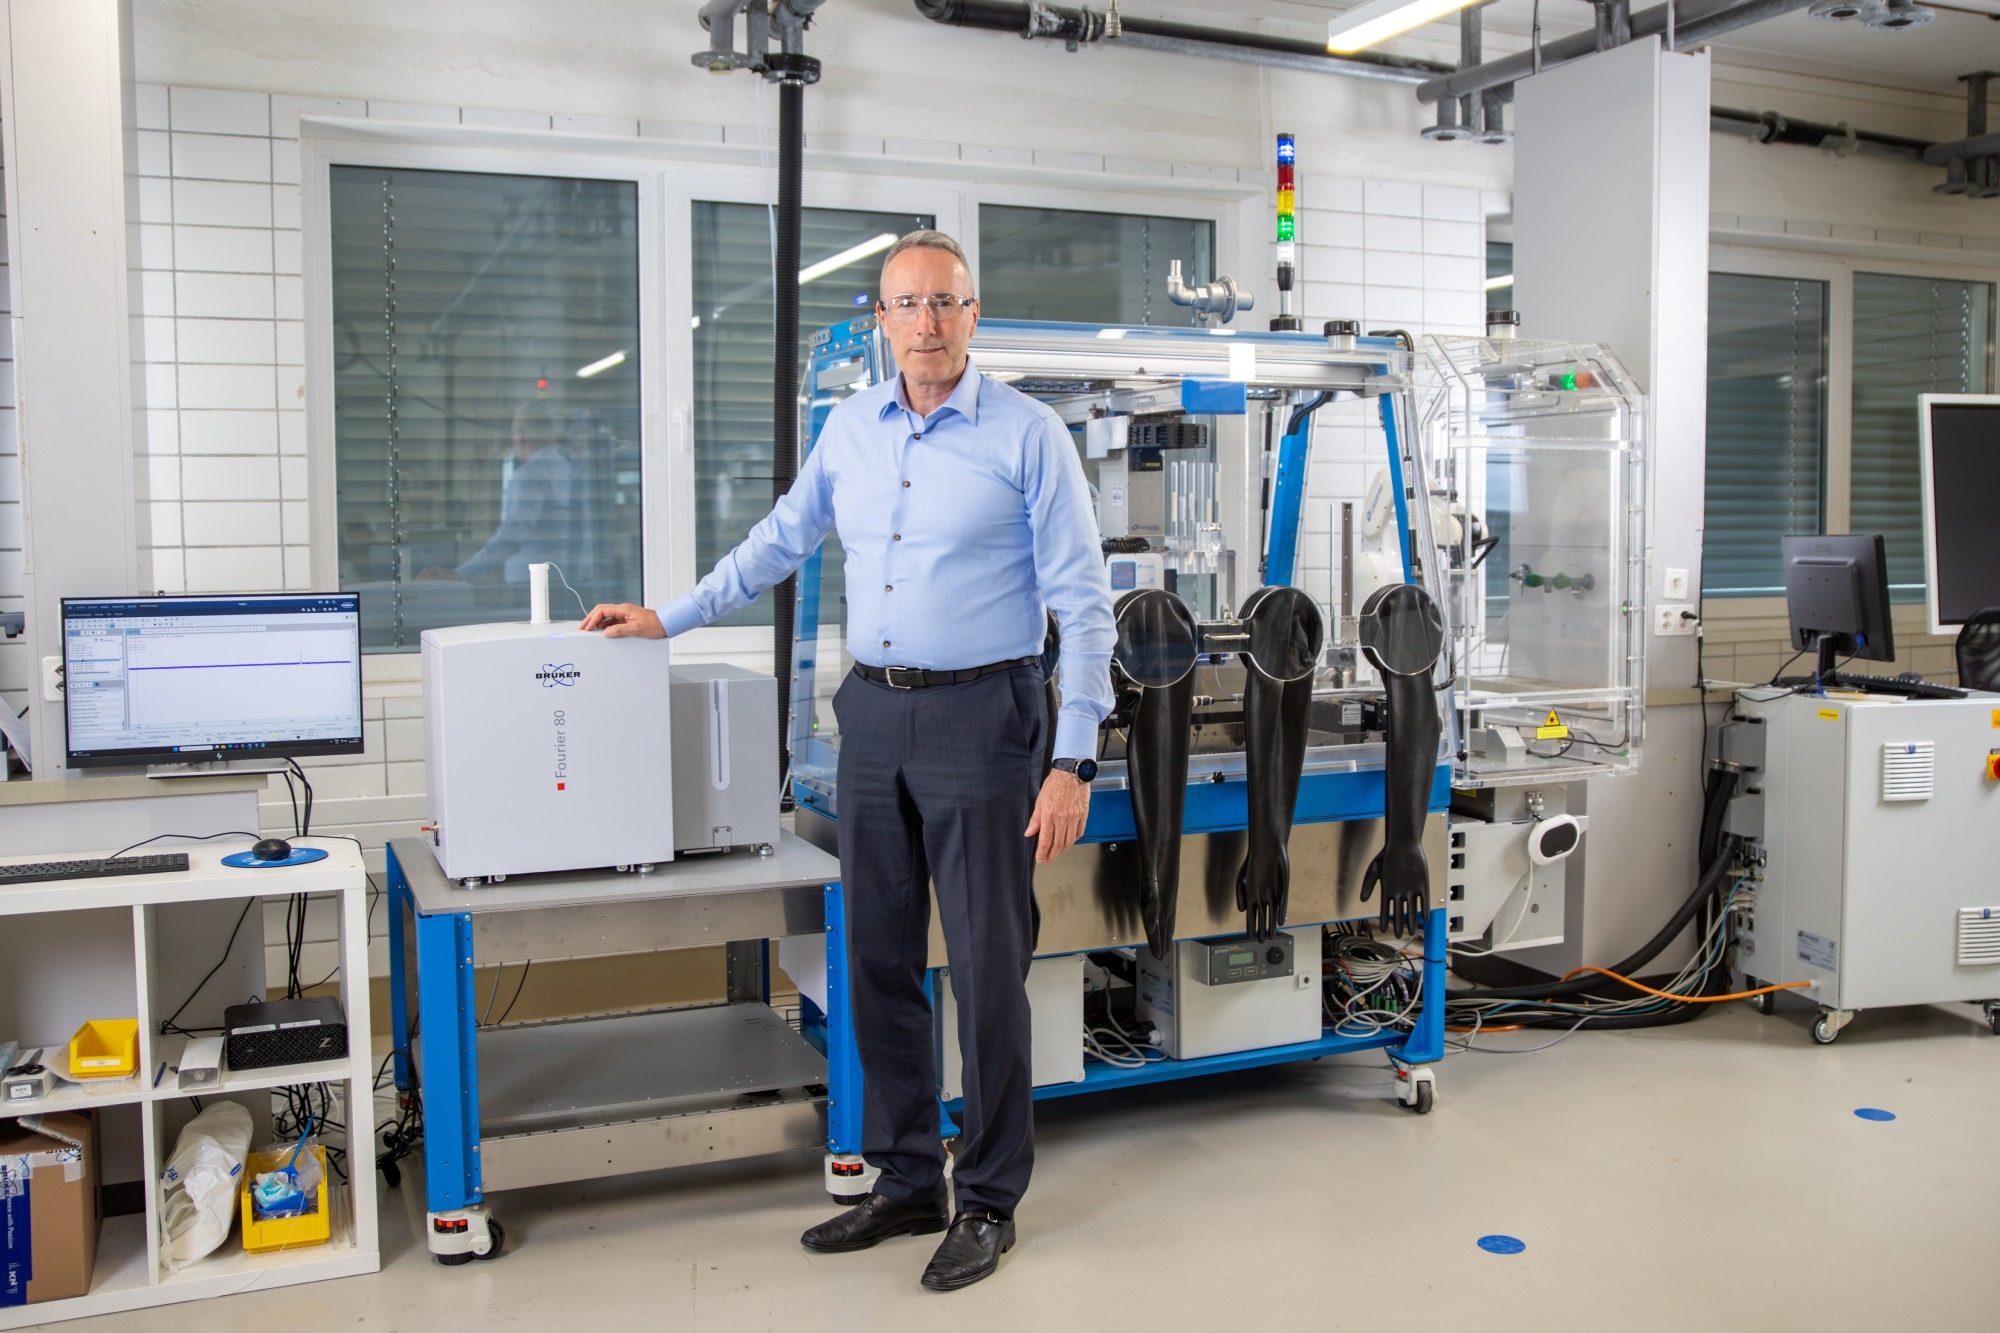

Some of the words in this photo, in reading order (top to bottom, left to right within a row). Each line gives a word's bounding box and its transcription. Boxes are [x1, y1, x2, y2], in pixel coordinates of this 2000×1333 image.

[535, 671, 581, 680] BRUKER
[553, 710, 565, 726] 80
[554, 730, 566, 779] Fourier
